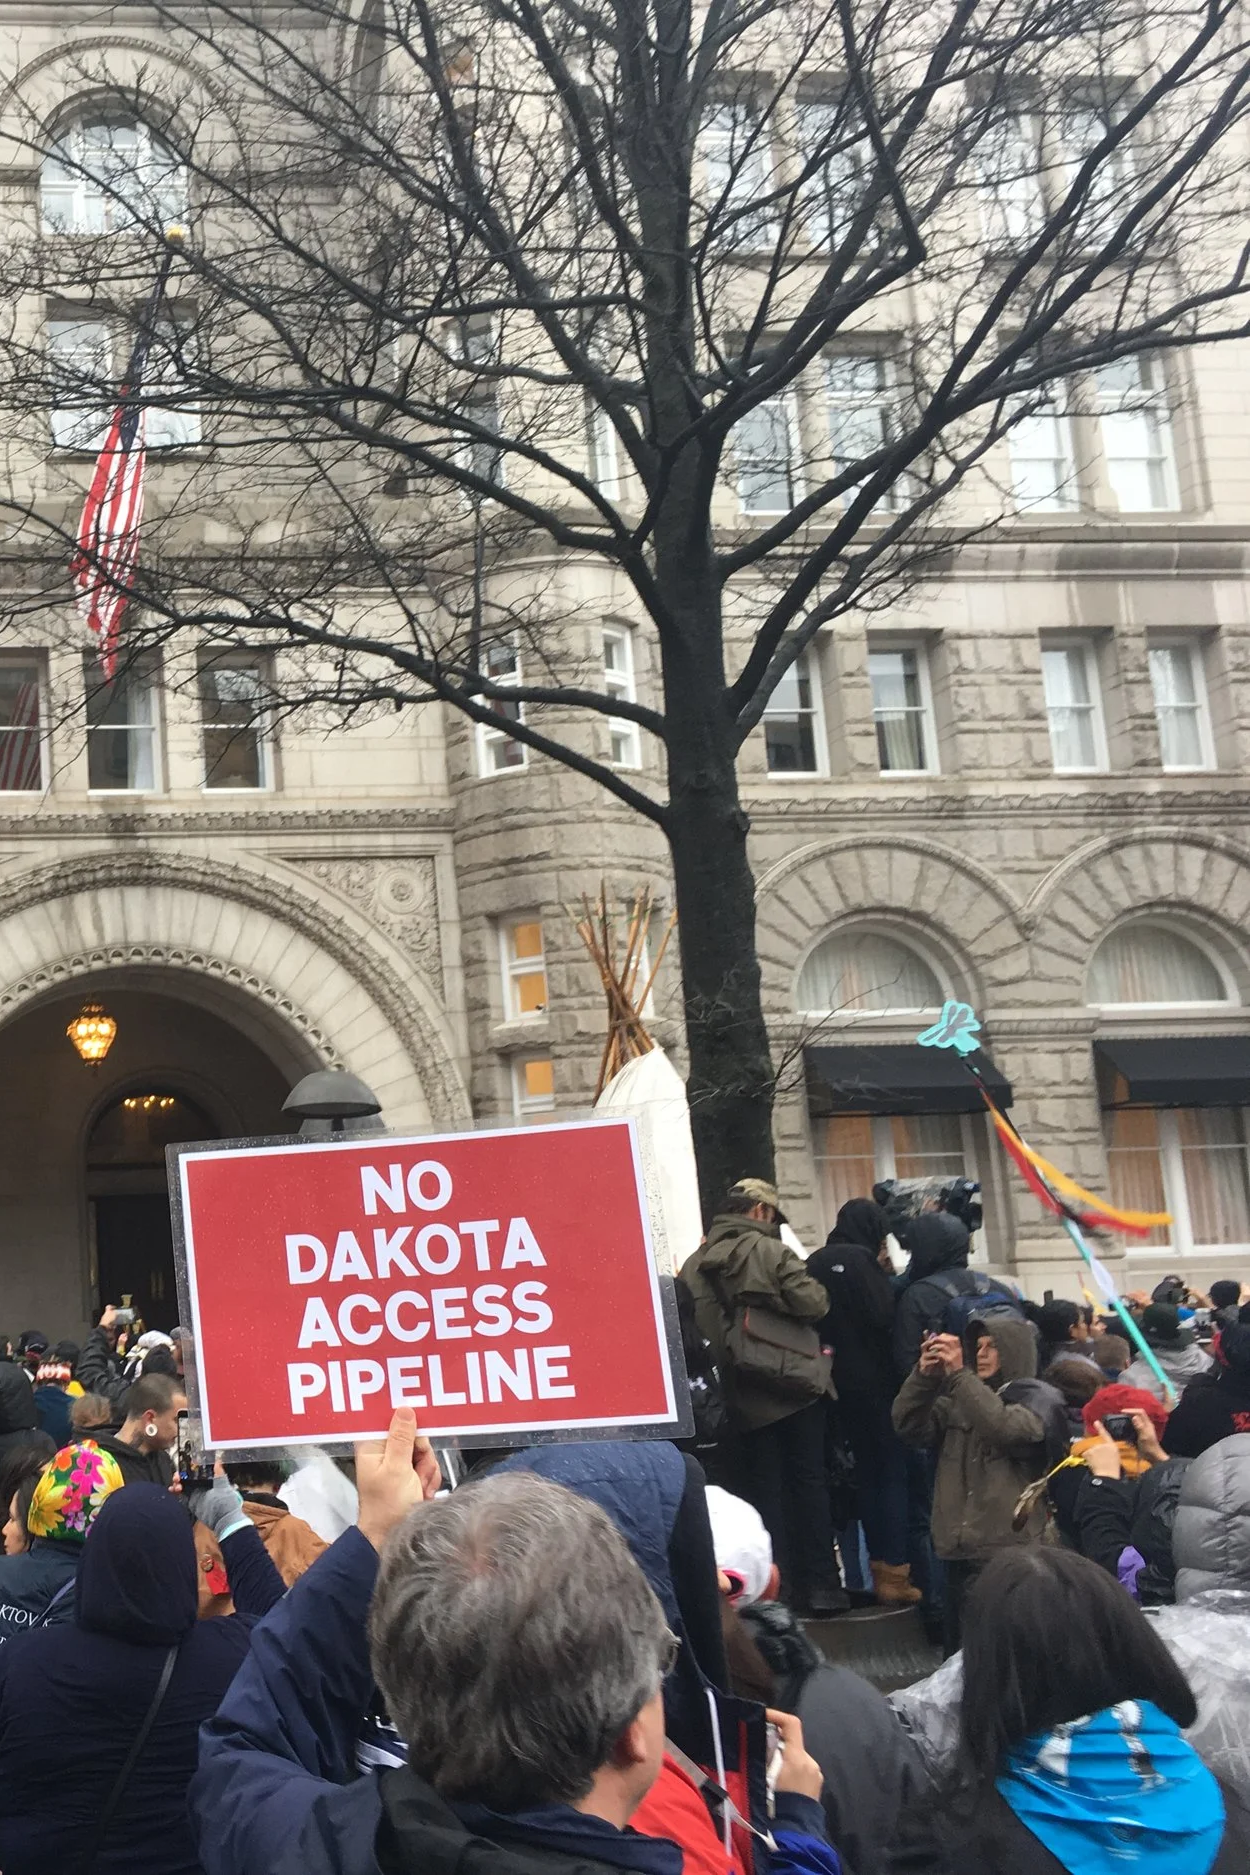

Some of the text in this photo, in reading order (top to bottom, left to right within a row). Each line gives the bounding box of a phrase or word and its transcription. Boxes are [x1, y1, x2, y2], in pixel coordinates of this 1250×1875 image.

[360, 1160, 453, 1216] NO
[285, 1217, 548, 1285] DAKOTA
[297, 1281, 553, 1349] ACCESS
[287, 1345, 576, 1415] PIPELINE
